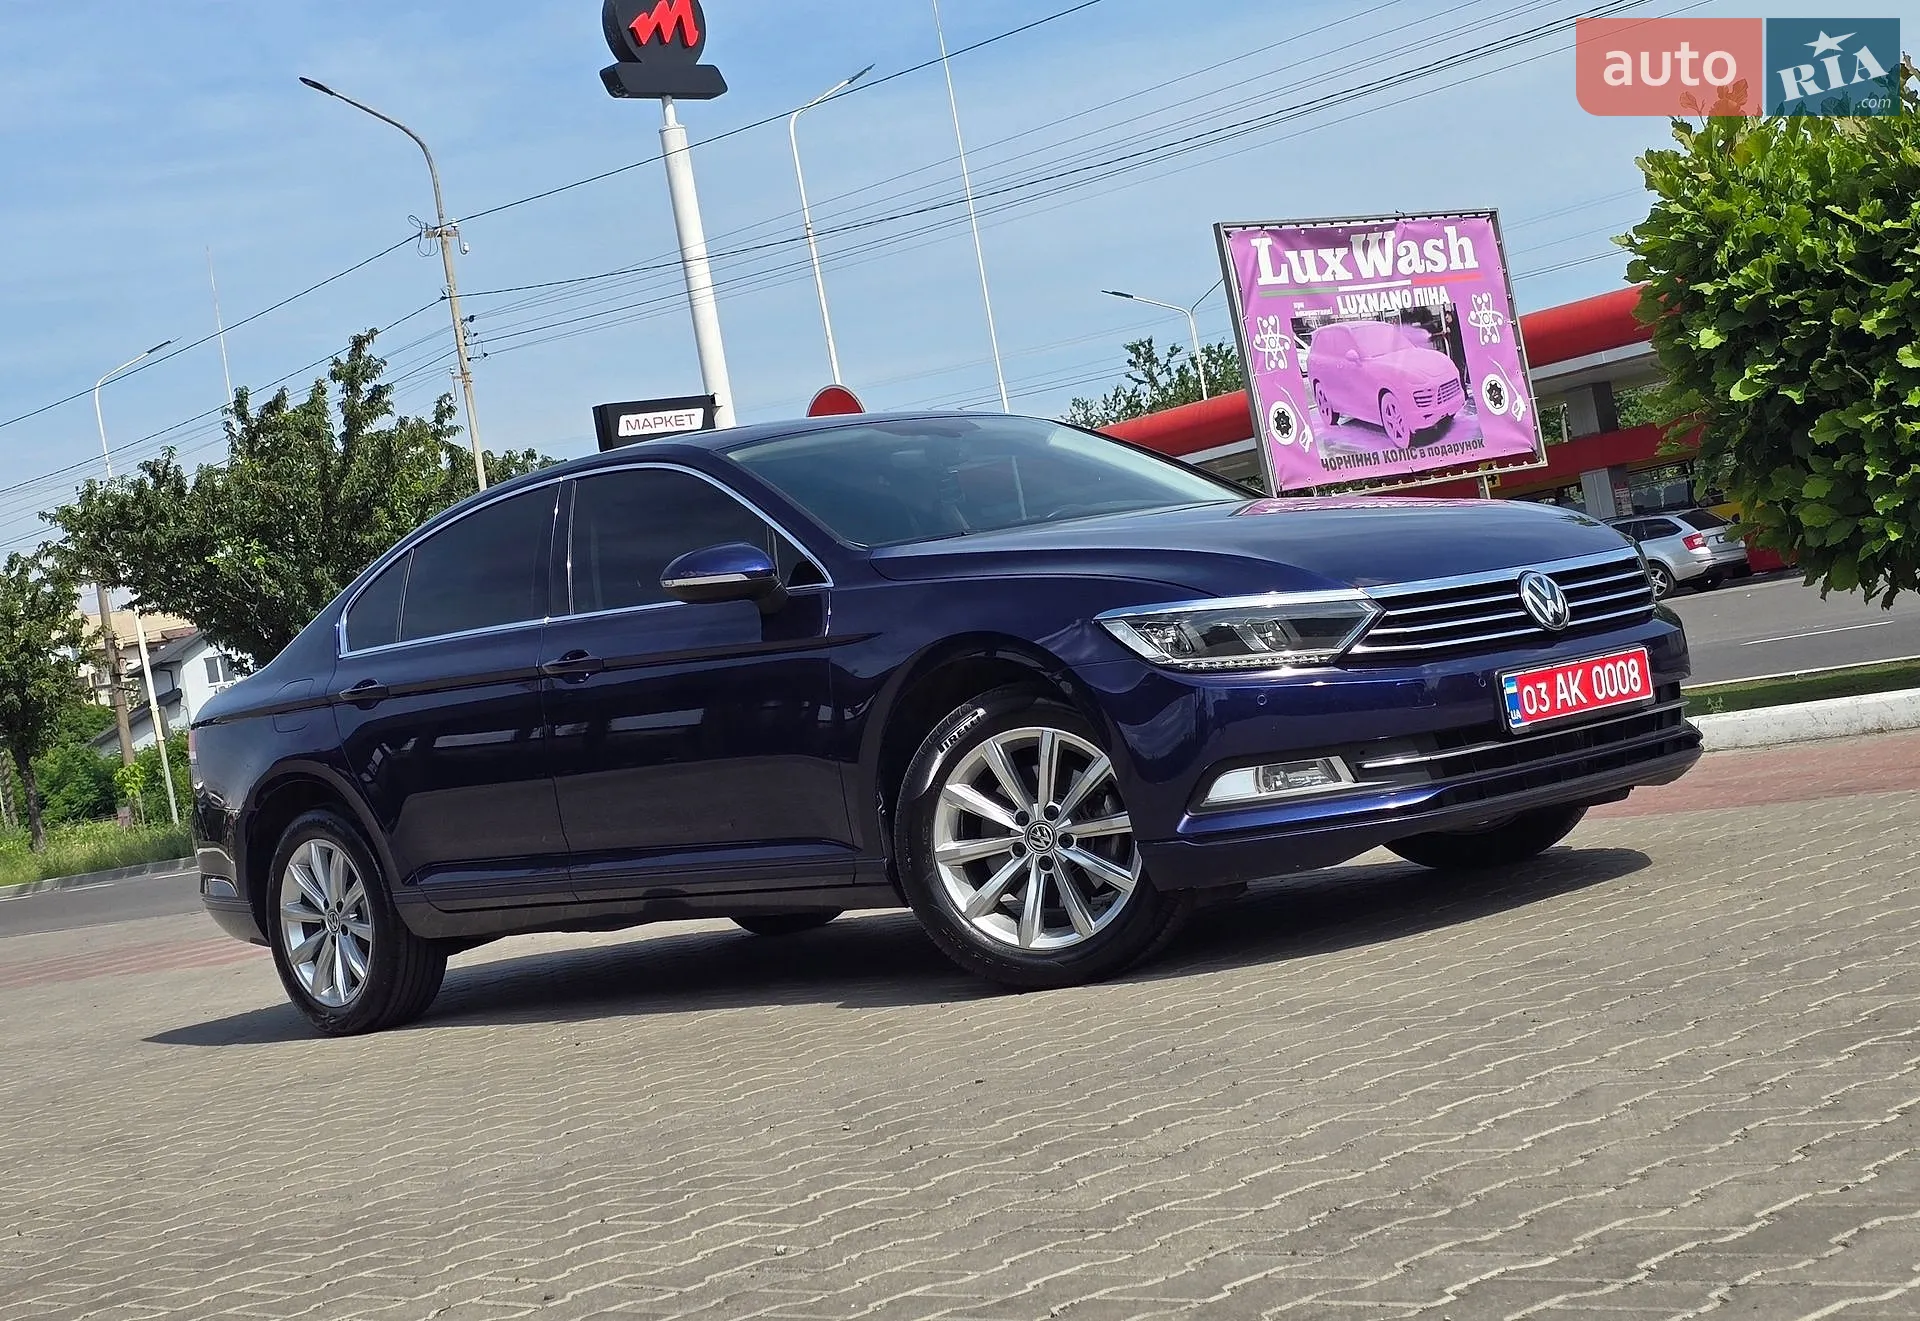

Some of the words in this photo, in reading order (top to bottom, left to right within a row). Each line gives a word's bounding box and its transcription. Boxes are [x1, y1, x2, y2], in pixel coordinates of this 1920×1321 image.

[1250, 225, 1479, 286] LuxWash
[1336, 289, 1412, 315] LUXNANO
[1413, 285, 1451, 307] ПІНА
[625, 413, 696, 431] МАРКЕТ
[1321, 451, 1380, 472] ЧОРНІННЯ
[1383, 447, 1418, 464] КОЛІС
[1427, 438, 1486, 458] подарунок
[1522, 682, 1551, 715] 03
[1591, 658, 1642, 700] 0008
[1510, 709, 1522, 720] UA
